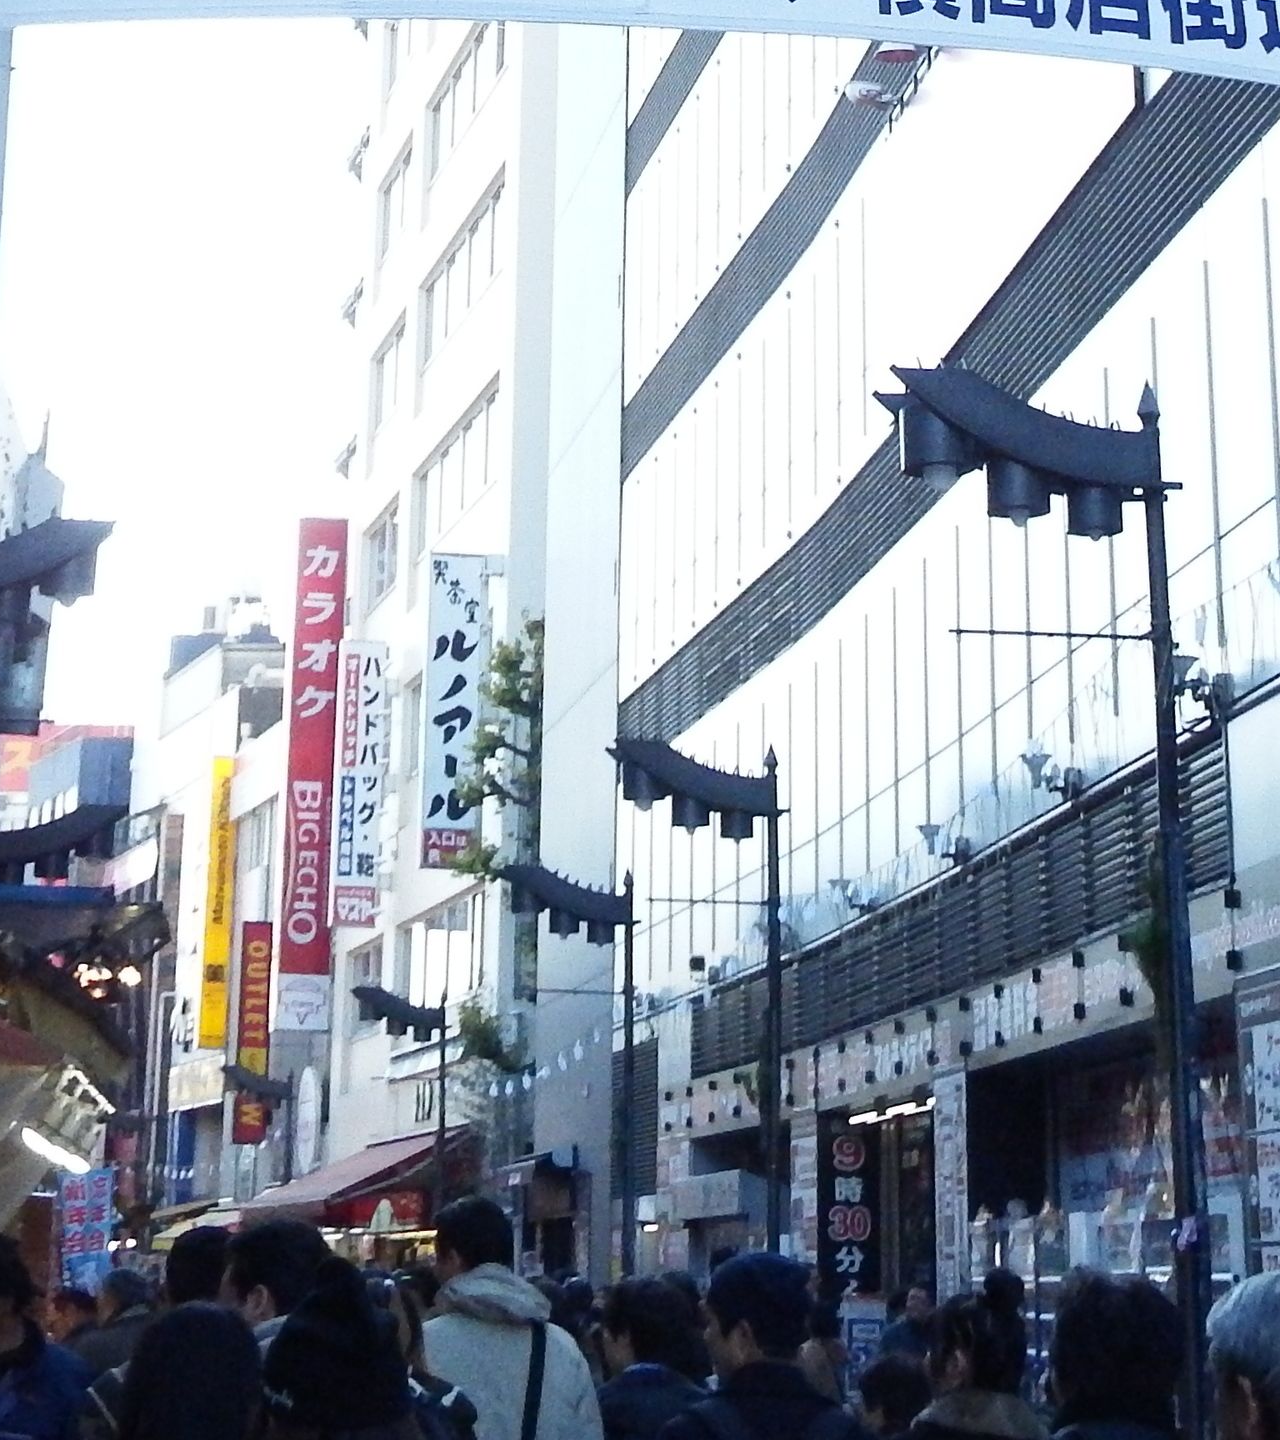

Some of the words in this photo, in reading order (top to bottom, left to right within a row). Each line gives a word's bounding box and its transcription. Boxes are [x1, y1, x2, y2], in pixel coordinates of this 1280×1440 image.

[296, 545, 339, 718] カラオケ
[426, 629, 479, 821] ルノアール
[292, 780, 322, 844] BIG
[287, 851, 319, 945] ECHO
[243, 940, 269, 1041] OUTLET
